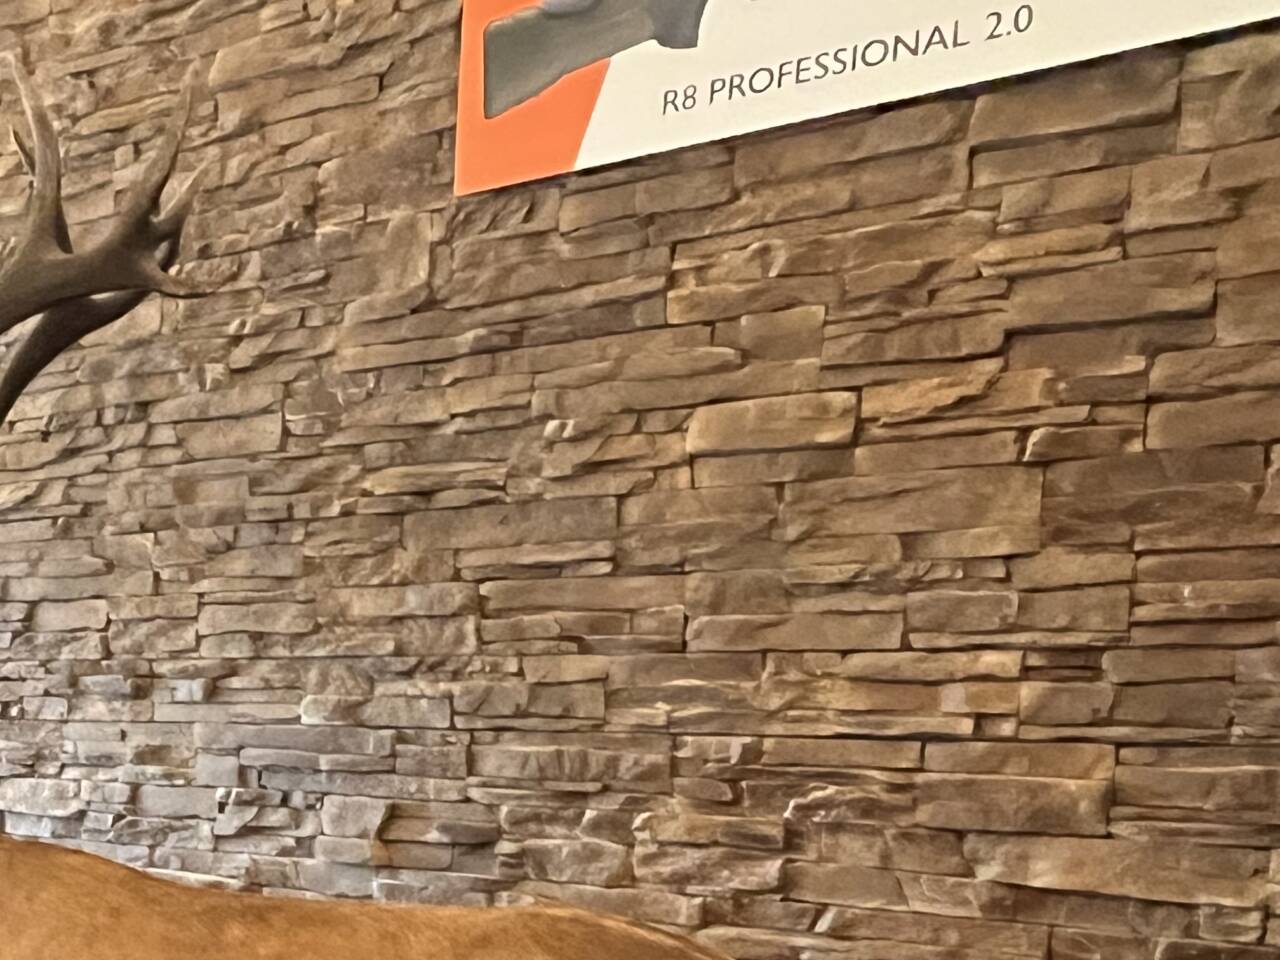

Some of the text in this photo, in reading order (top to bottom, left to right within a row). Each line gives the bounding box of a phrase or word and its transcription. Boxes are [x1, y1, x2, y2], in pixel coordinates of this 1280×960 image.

[662, 4, 1034, 115] R8 PROFESSIONAL 2.0
